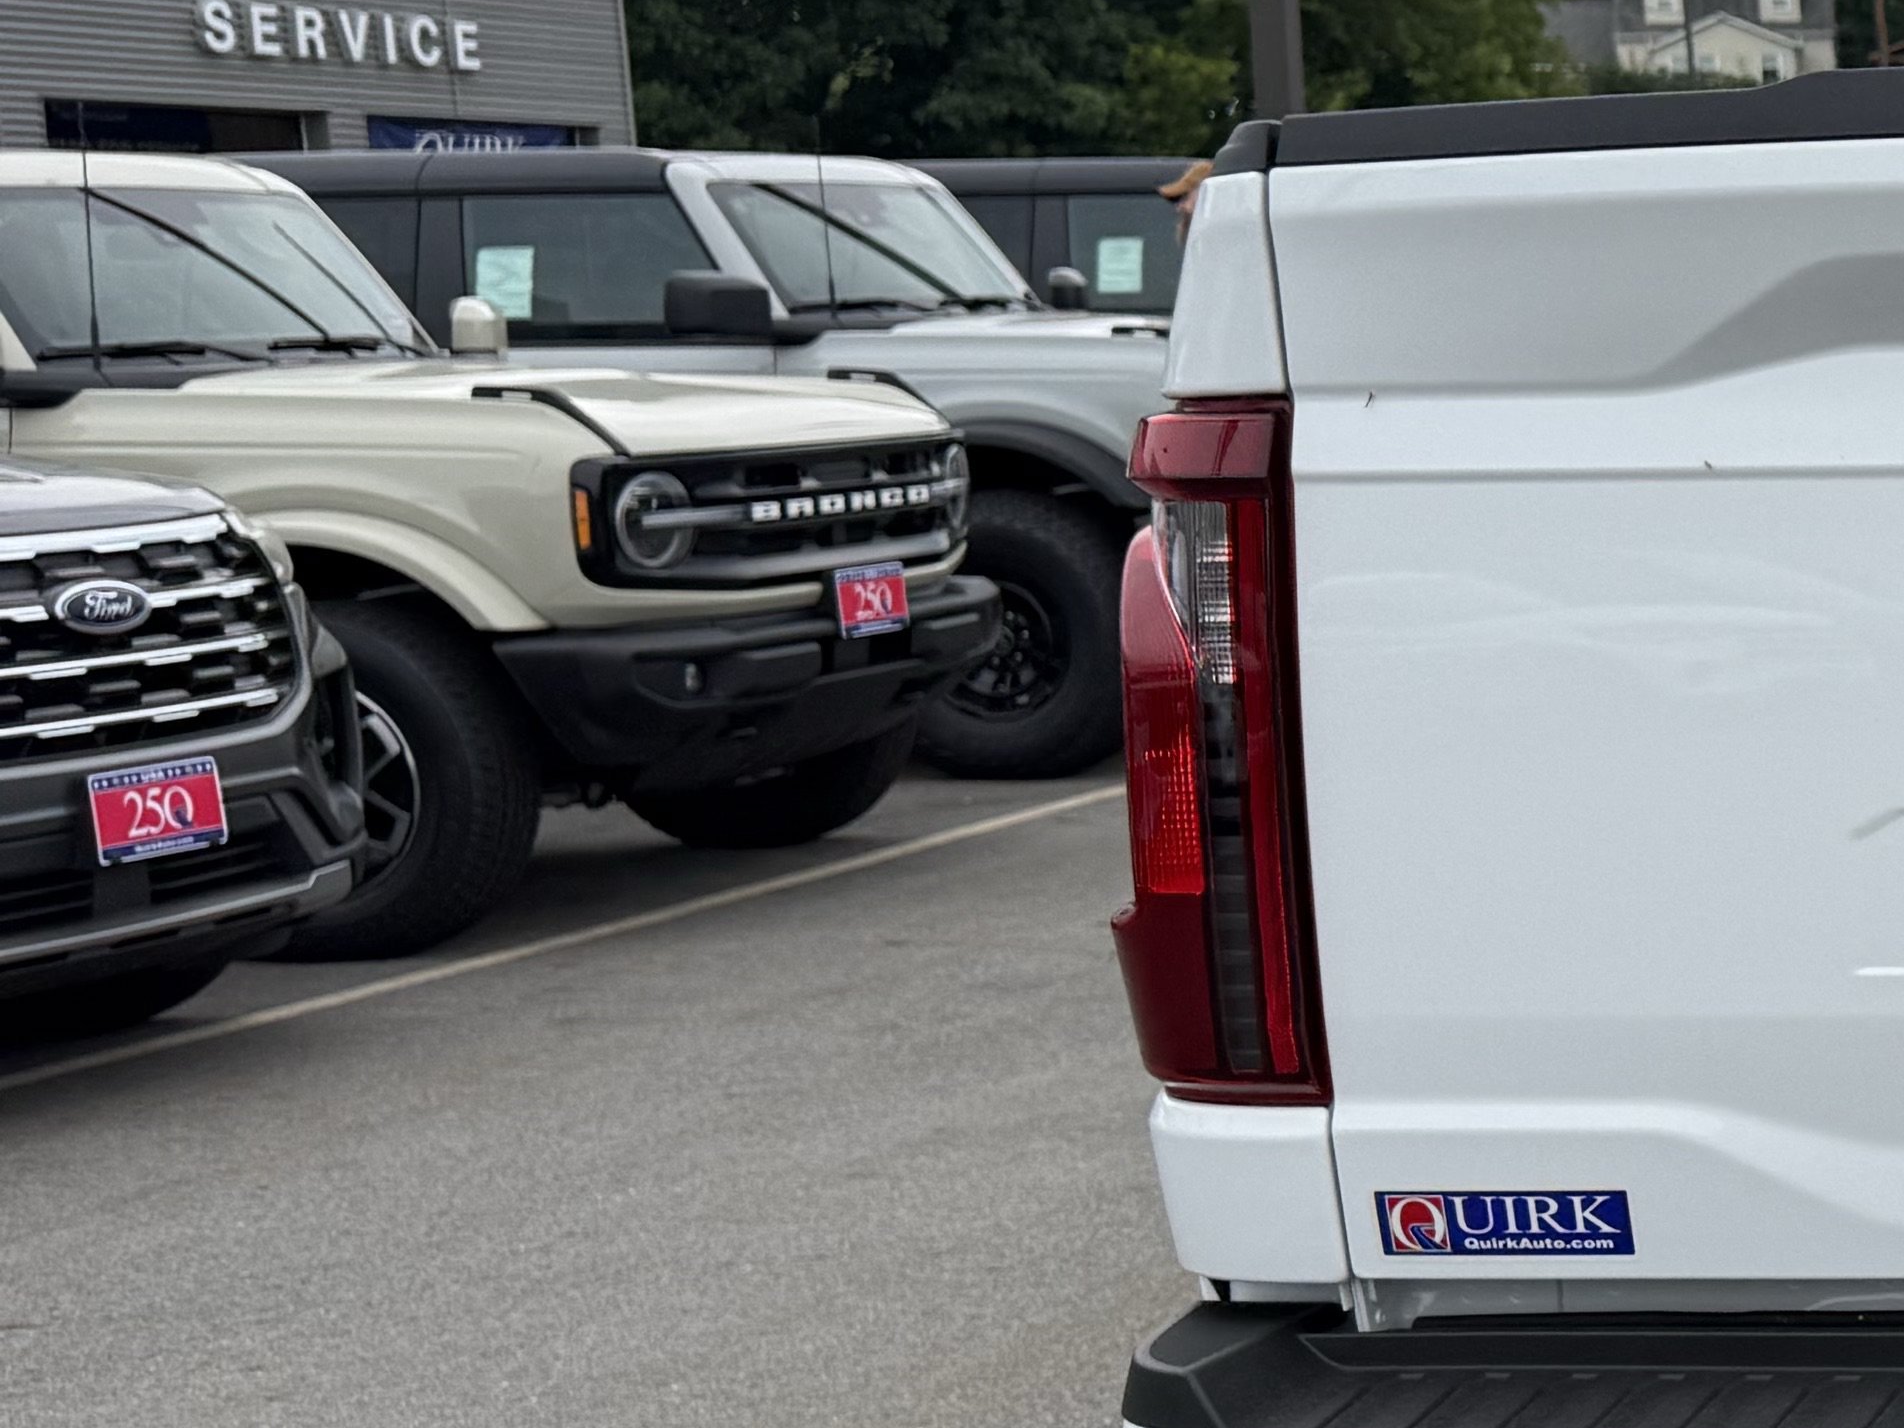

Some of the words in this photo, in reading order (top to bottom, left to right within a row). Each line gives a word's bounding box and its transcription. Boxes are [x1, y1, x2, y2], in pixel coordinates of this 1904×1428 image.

[751, 484, 930, 522] BRONCO
[1390, 1195, 1622, 1252] QUIRK
[1463, 1236, 1616, 1251] QuirkAuto.com
